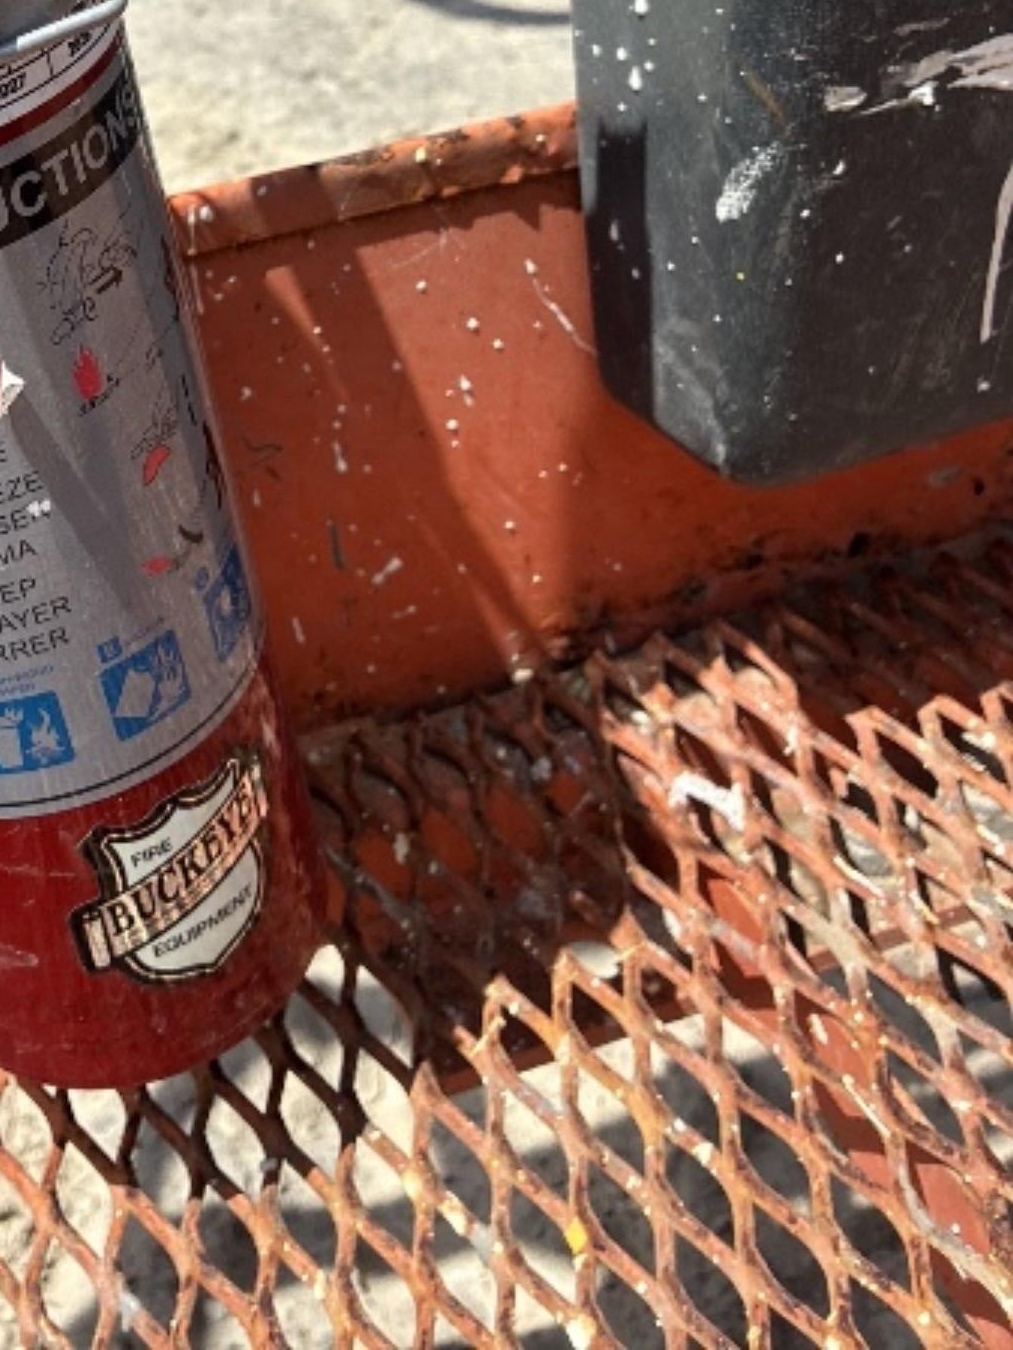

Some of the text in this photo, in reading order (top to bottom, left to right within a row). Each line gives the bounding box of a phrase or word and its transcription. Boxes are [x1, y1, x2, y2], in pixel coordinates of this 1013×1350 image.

[106, 777, 260, 937] BUCKEYE
[130, 834, 172, 867] FIRE
[152, 883, 252, 959] EQUIPMENT
